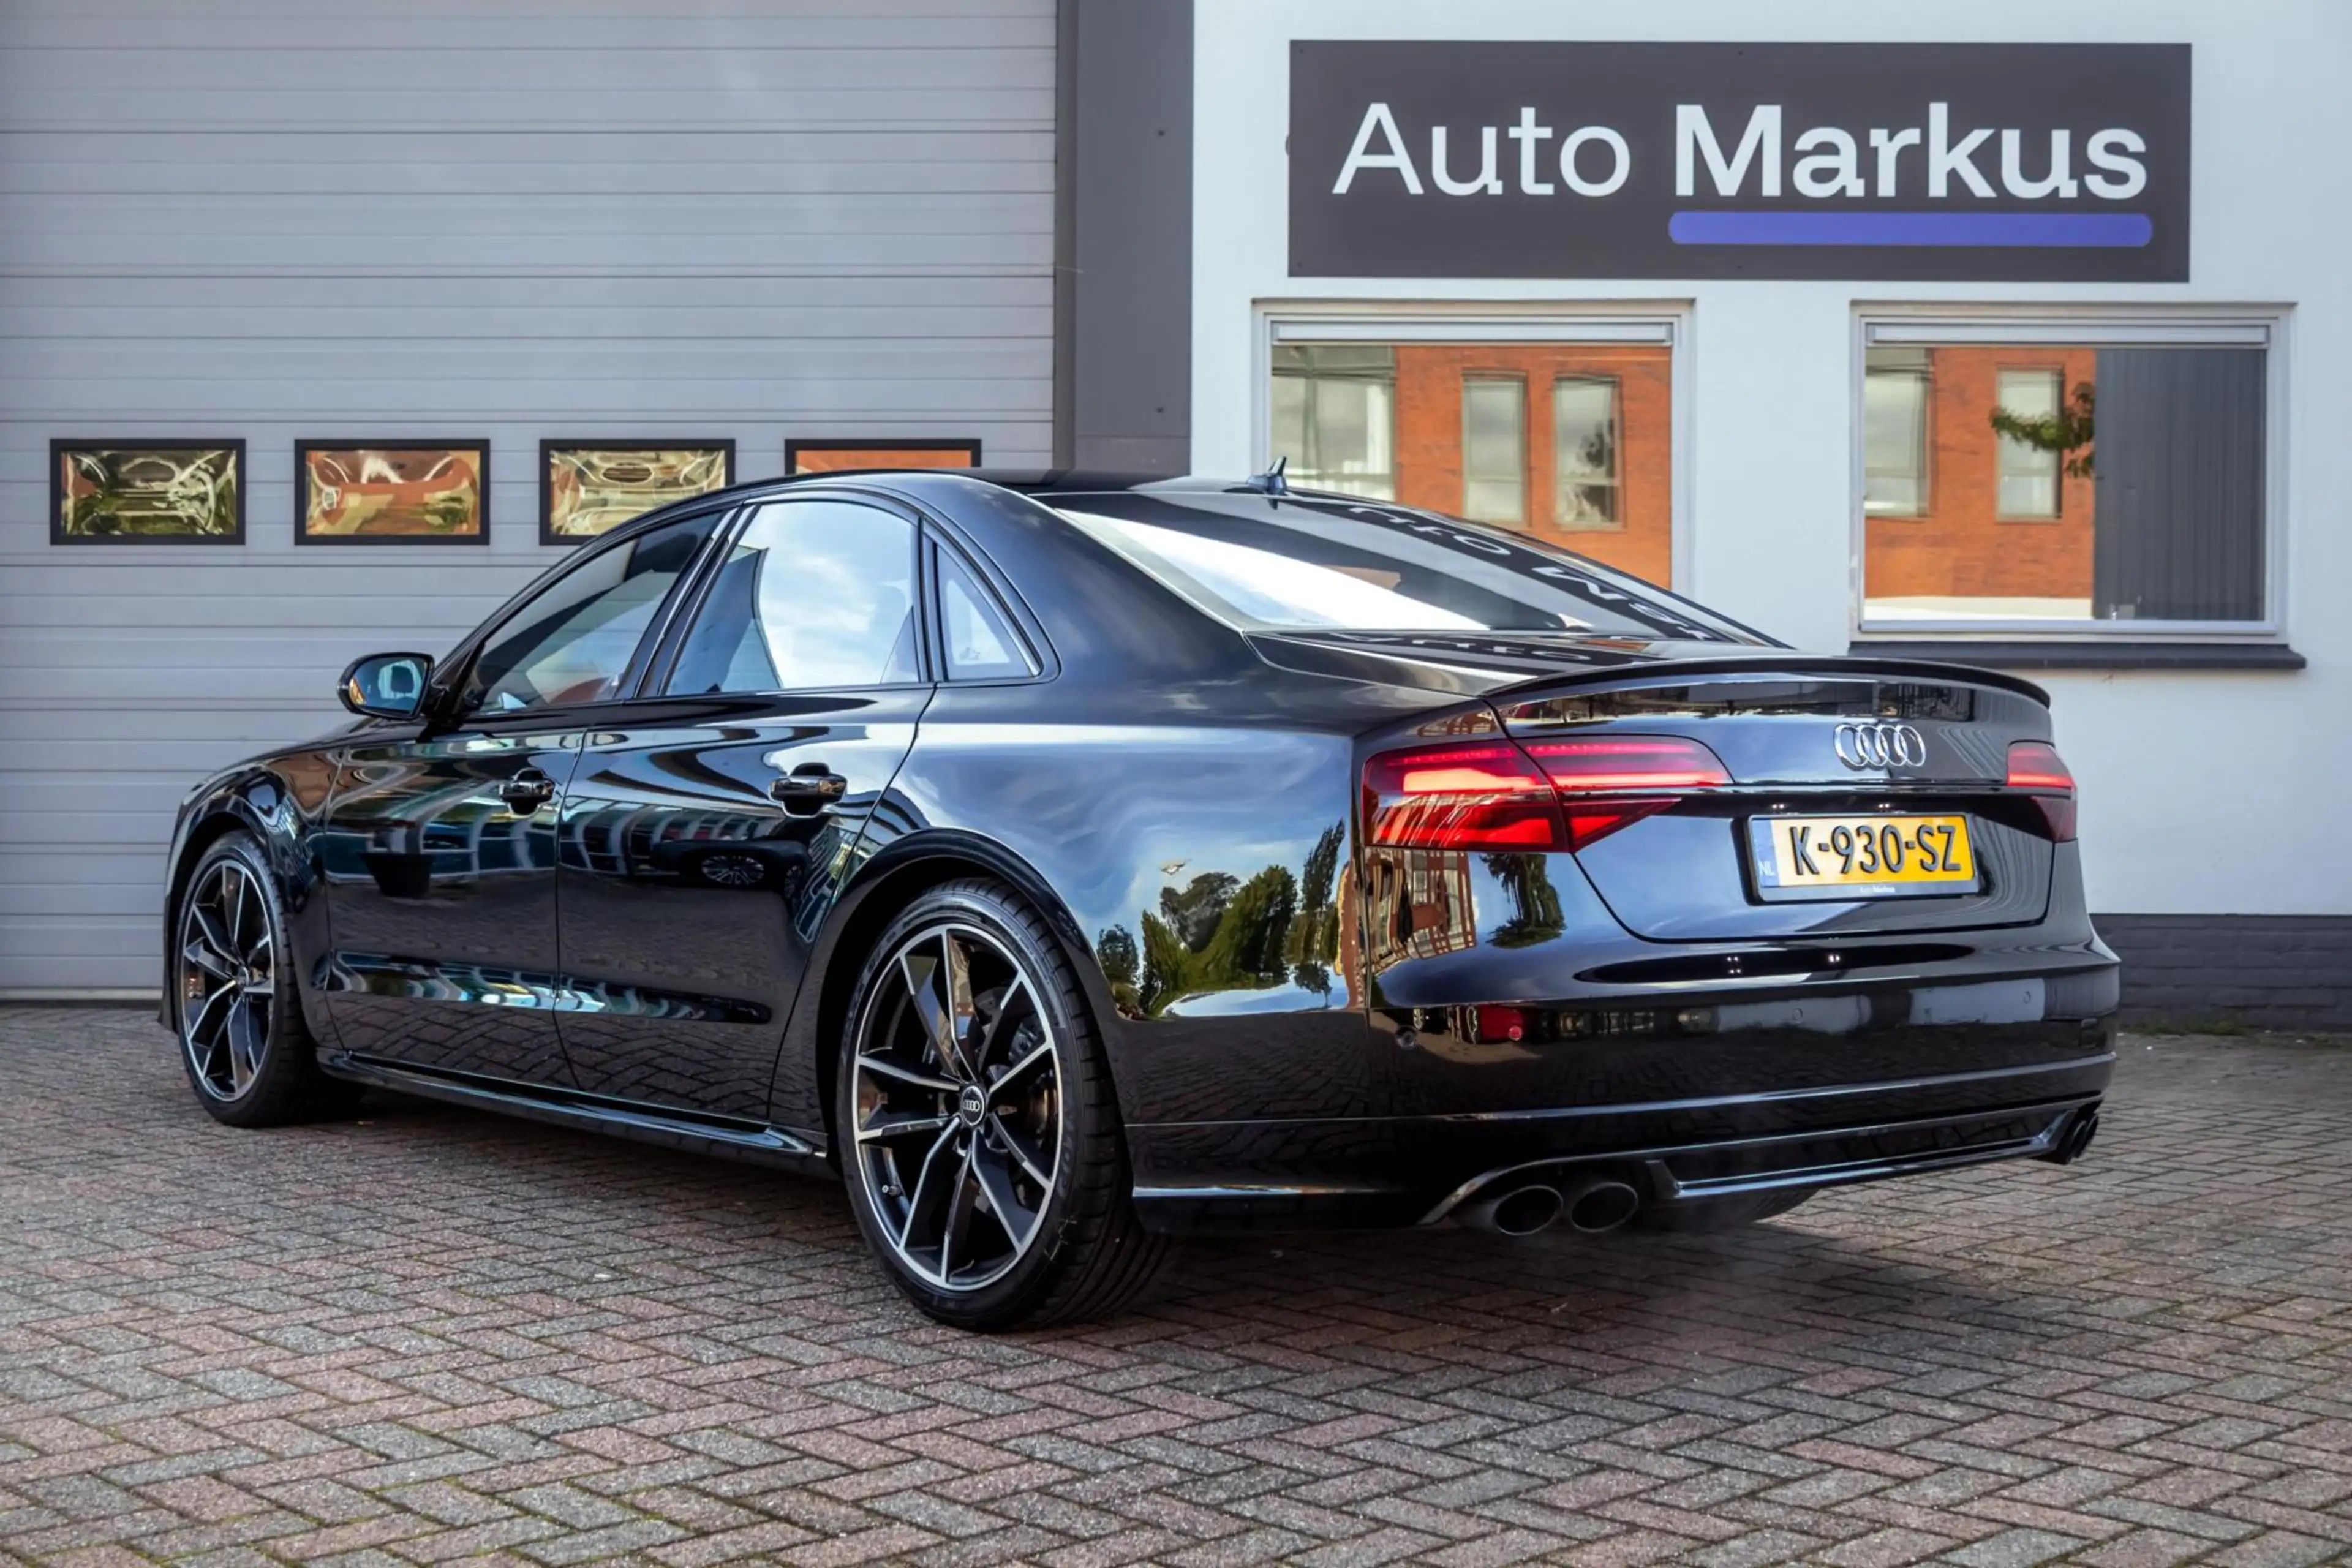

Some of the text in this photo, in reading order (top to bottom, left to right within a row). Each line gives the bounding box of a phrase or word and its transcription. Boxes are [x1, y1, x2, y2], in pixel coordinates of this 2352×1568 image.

[1332, 102, 2147, 199] Auto Markus
[1758, 861, 1775, 876] NL
[1789, 824, 1962, 875] K-930-SZ
